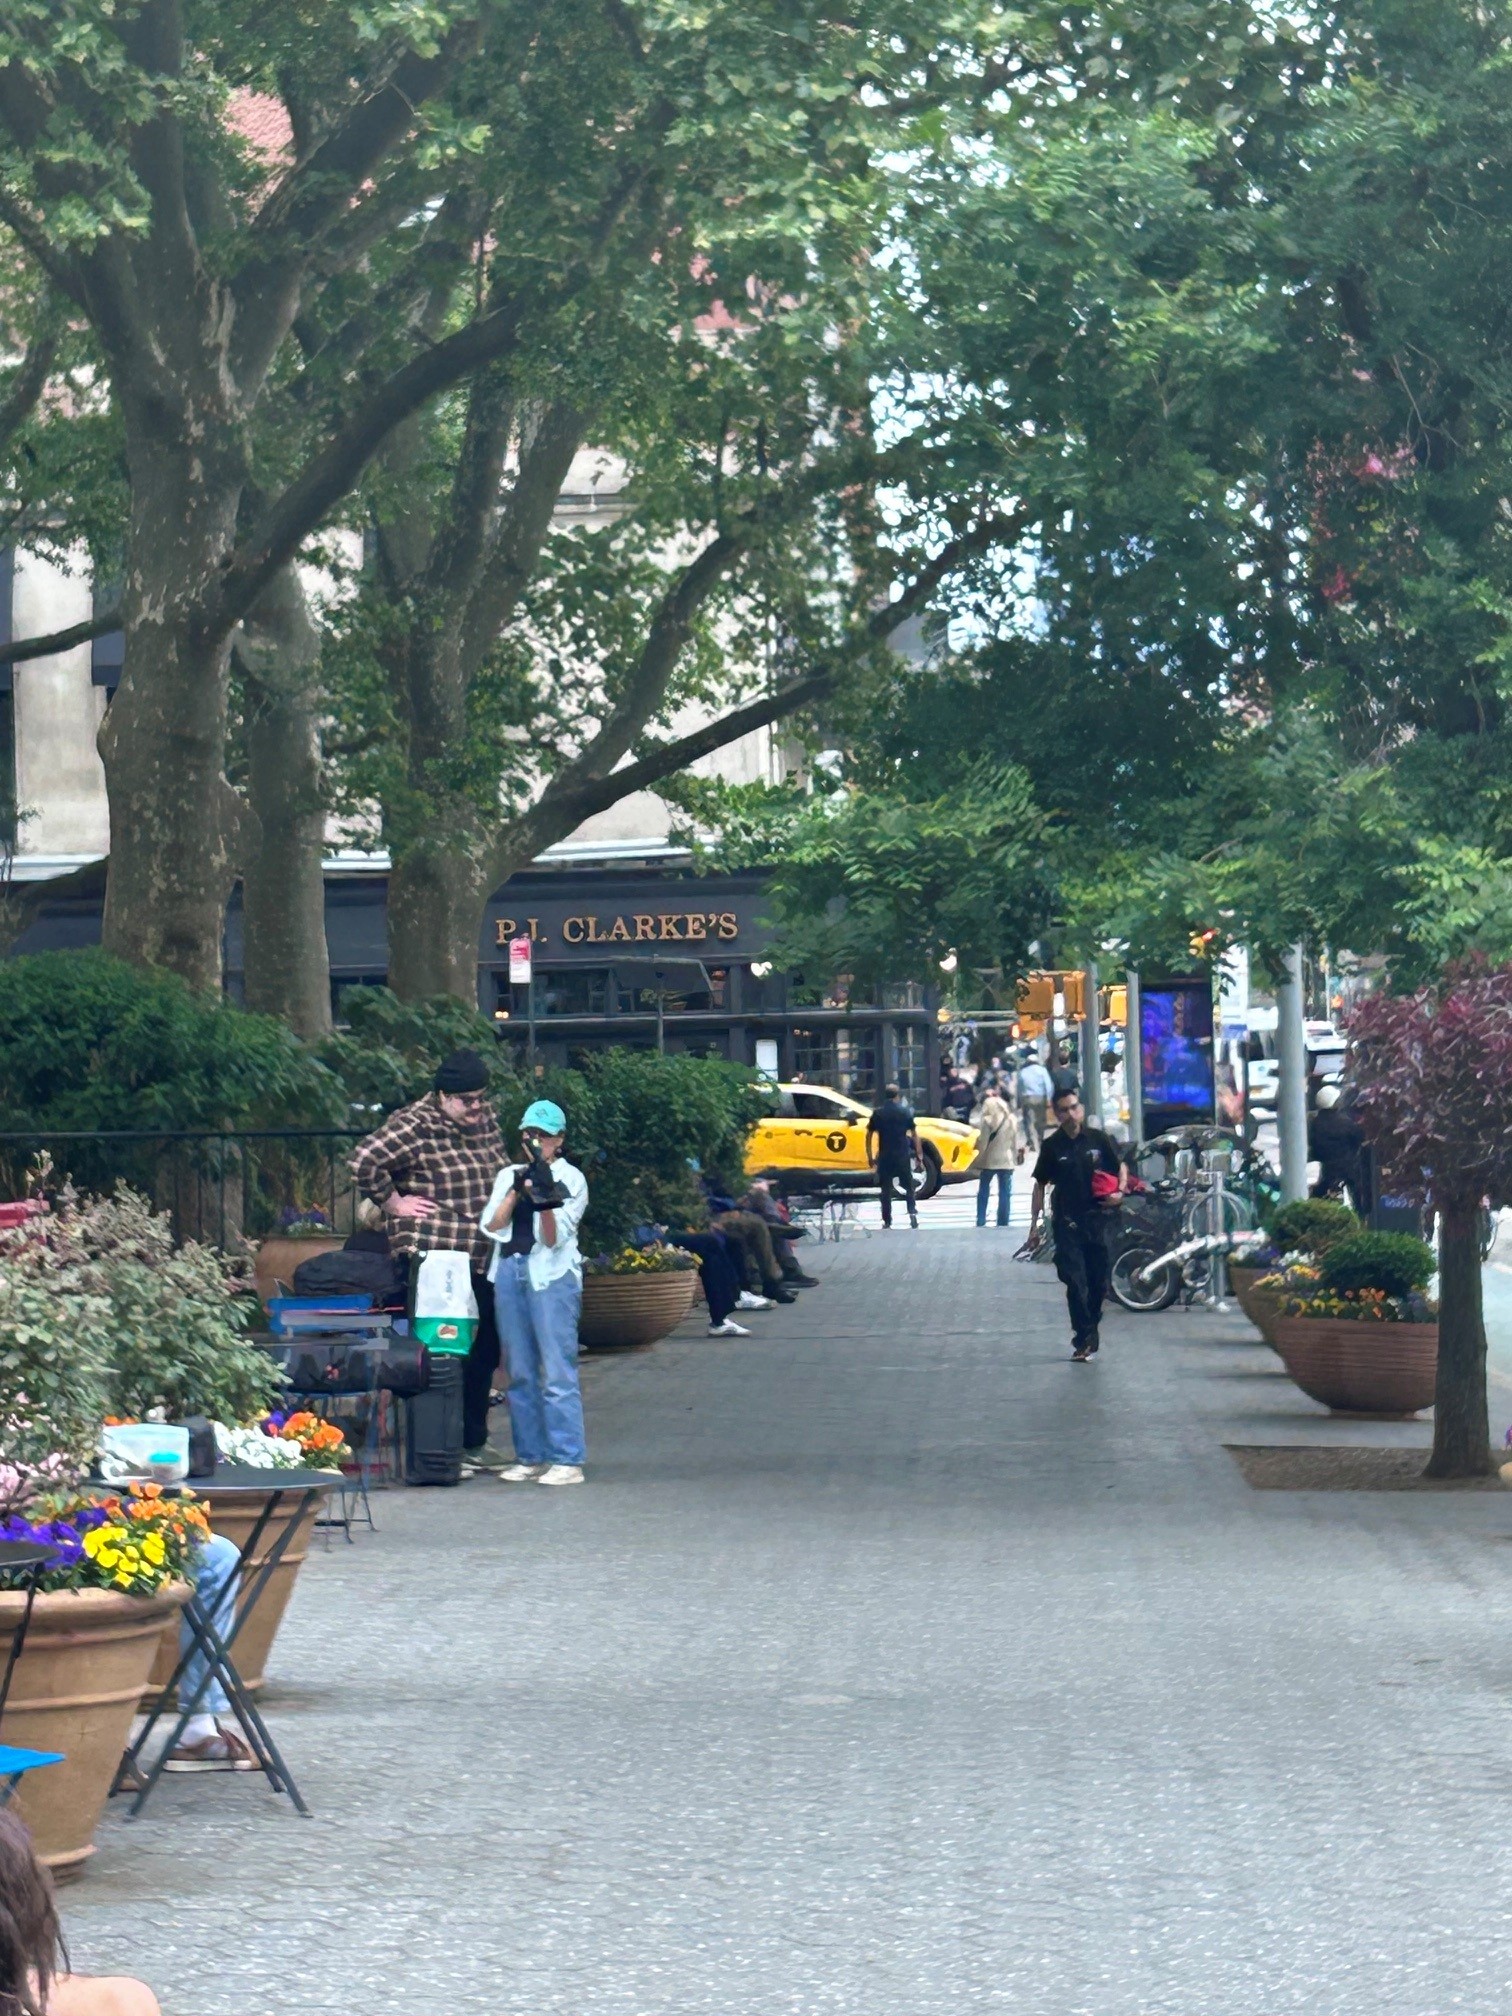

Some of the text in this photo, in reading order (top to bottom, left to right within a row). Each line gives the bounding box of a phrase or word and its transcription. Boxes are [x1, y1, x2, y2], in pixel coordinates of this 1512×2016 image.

[495, 913, 738, 944] PJ. CLARKE'S
[829, 1135, 845, 1150] T
